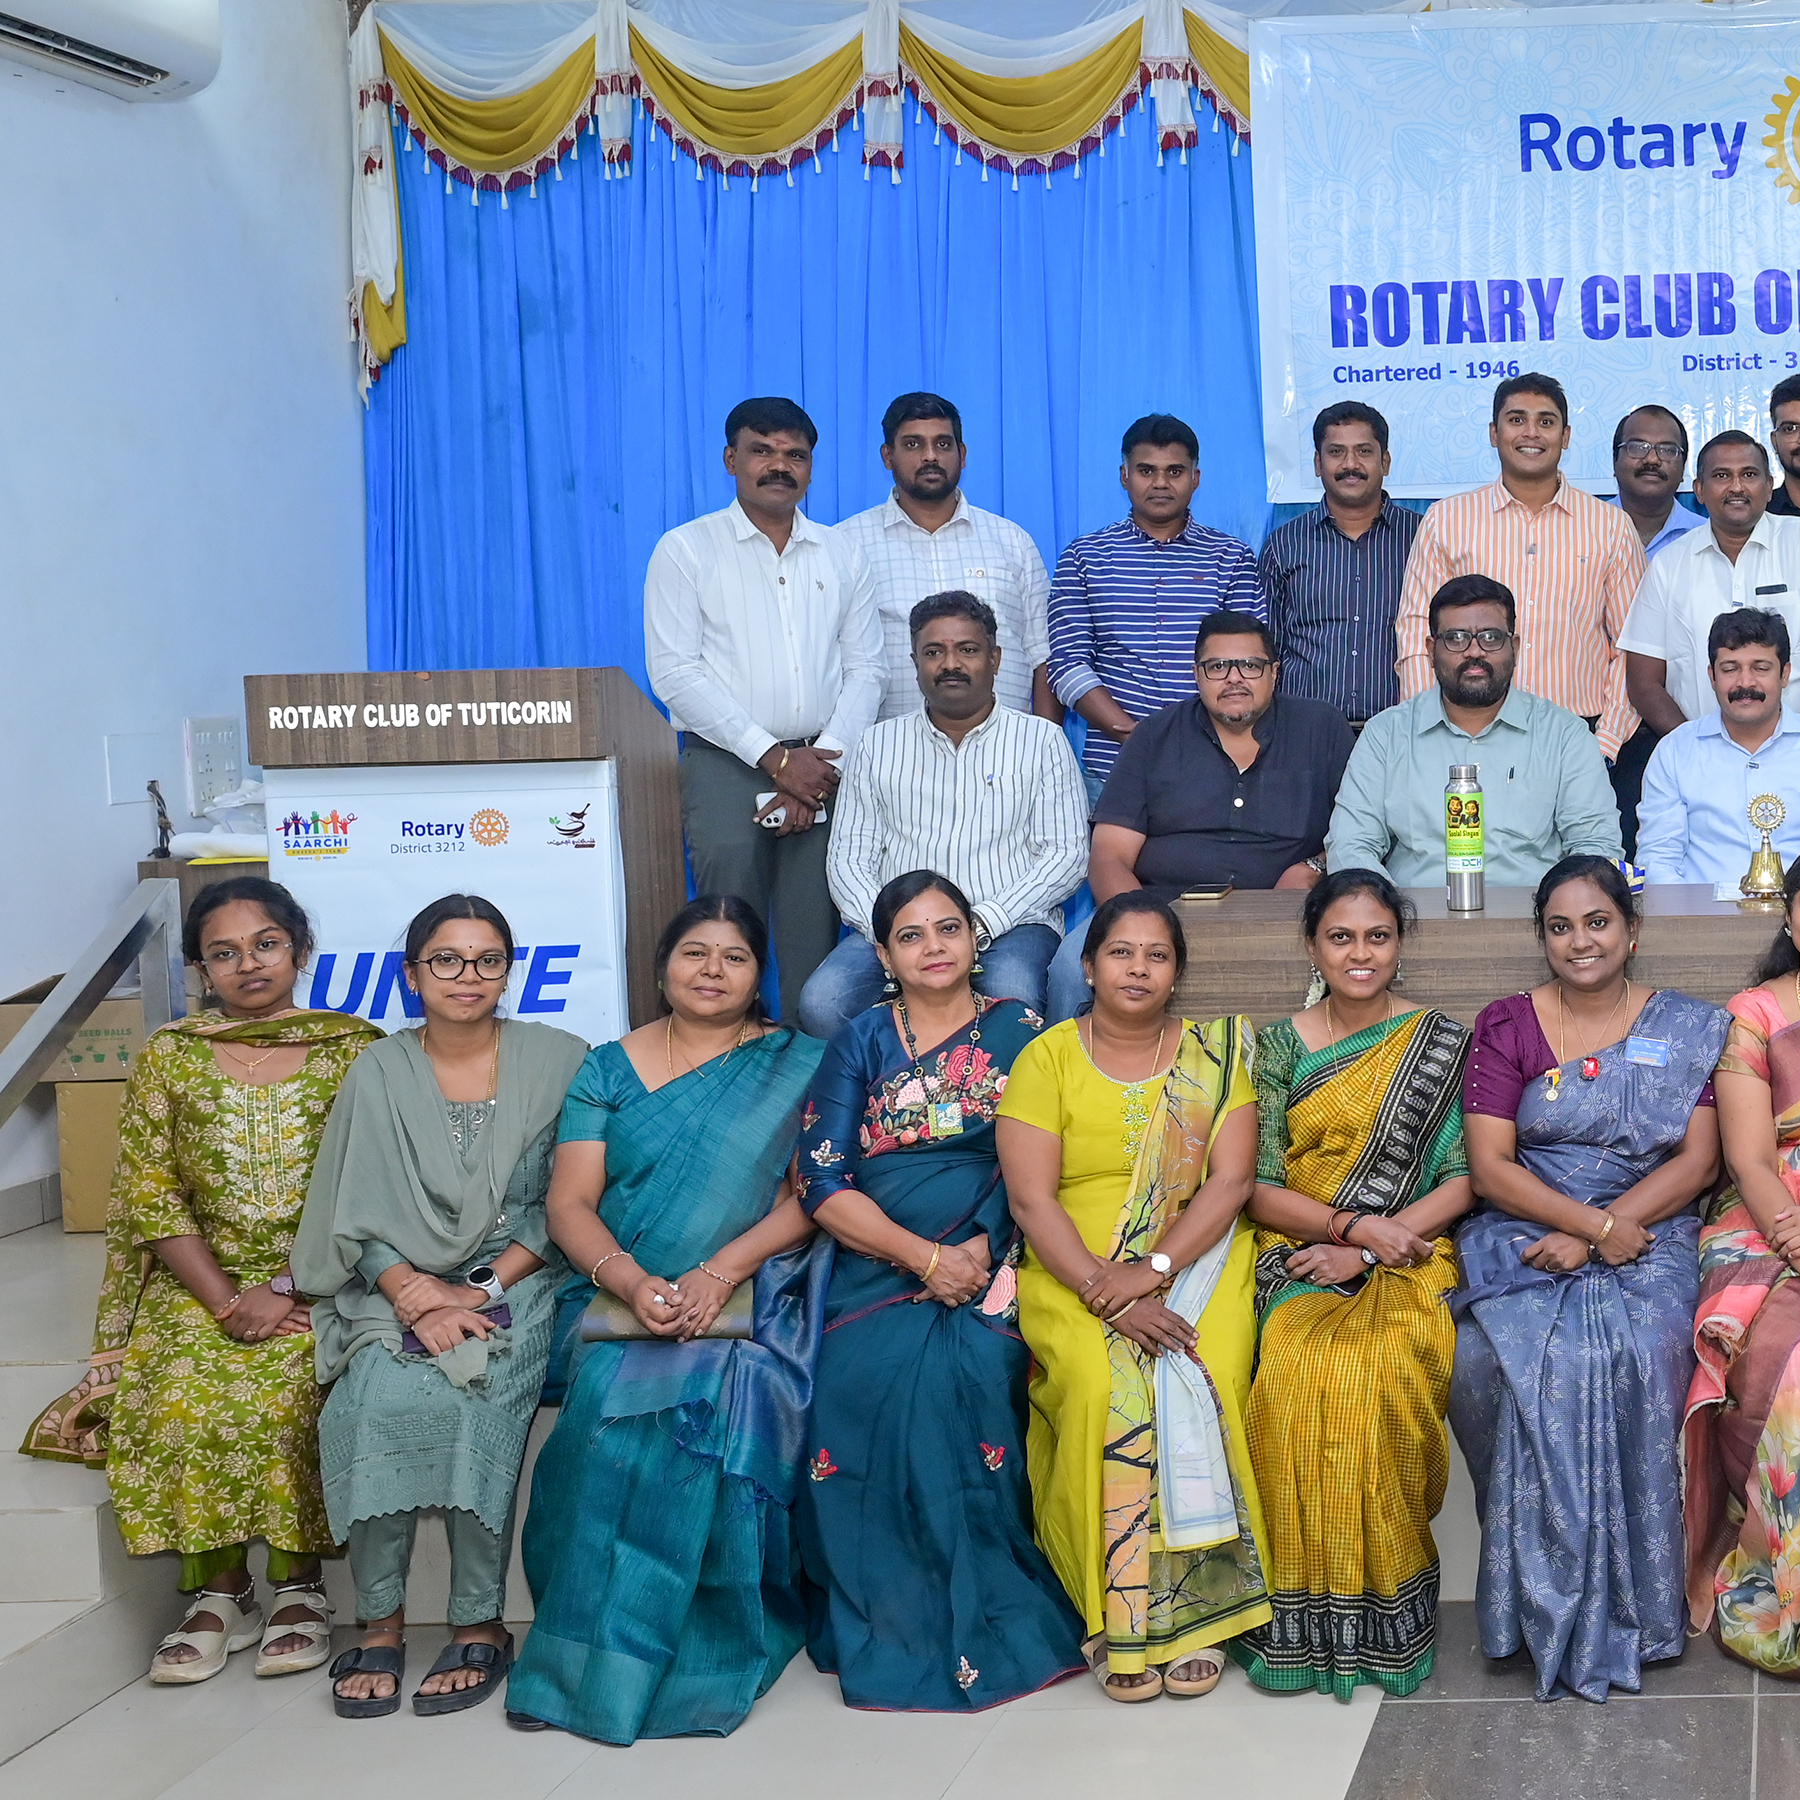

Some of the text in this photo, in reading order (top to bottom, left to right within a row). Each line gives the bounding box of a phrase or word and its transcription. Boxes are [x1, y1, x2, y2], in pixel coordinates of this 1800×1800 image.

[1519, 112, 1748, 180] Rotary
[1329, 276, 1564, 349] ROTARY
[1580, 271, 1737, 342] CLUB
[1332, 361, 1442, 384] Chartered
[1465, 359, 1521, 380] 1946
[1682, 352, 1763, 372] District
[268, 700, 573, 730] ROTARY CLUB OF TUTICORIN
[401, 820, 465, 839] Rotary
[283, 837, 348, 849] SAARCHI
[390, 841, 466, 854] District 3212
[104, 1028, 132, 1036] BALLS
